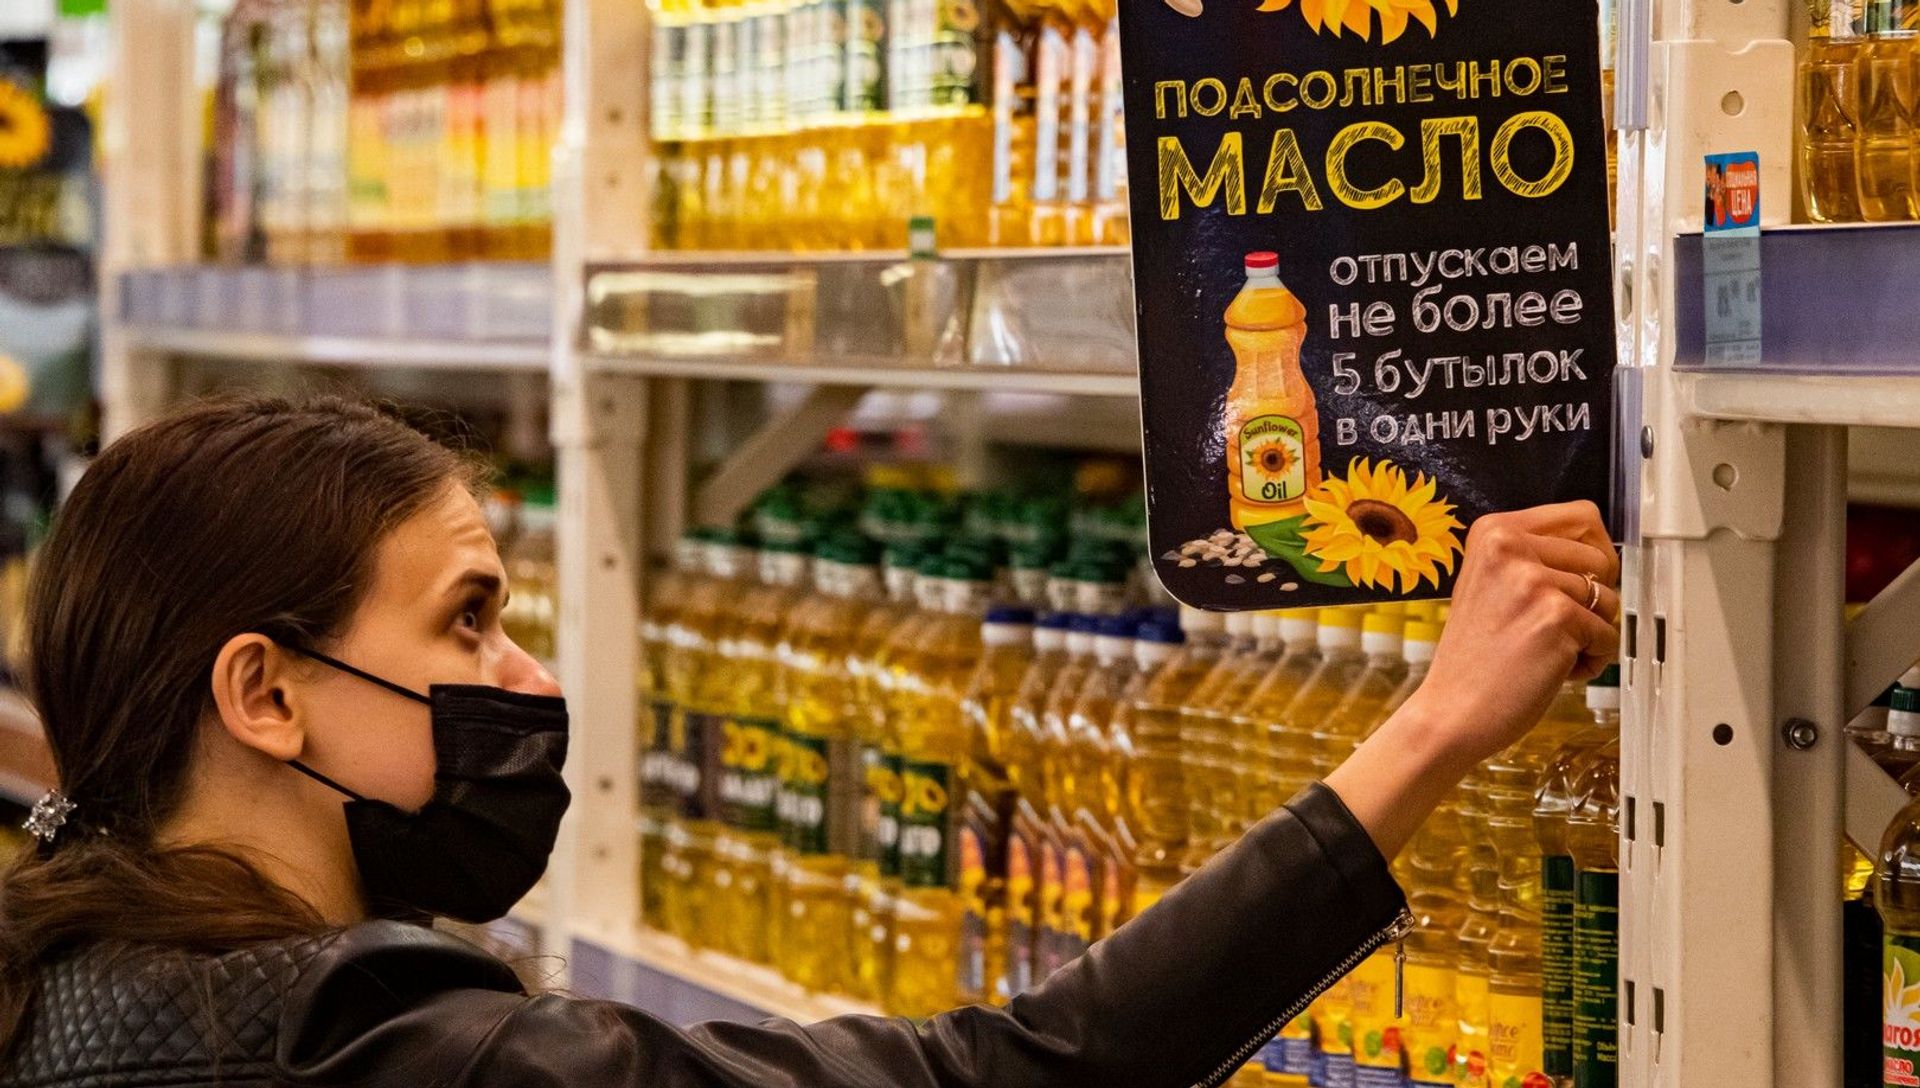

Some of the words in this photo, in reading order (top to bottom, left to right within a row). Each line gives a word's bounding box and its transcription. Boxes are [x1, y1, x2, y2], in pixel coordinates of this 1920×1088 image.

[1154, 54, 1570, 120] ПОДСОЛНЕЧНОЕ
[1157, 110, 1575, 221] МАСЛО
[1329, 241, 1579, 287] отпускаем
[1328, 300, 1396, 339] не
[1412, 284, 1584, 334] более
[1332, 352, 1361, 395] 5
[1374, 347, 1588, 398] бутылок
[1243, 420, 1299, 440] Sunflower
[1336, 417, 1358, 446] в
[1370, 408, 1476, 447] одни
[1487, 402, 1591, 445] руки
[1261, 480, 1288, 500] Oil
